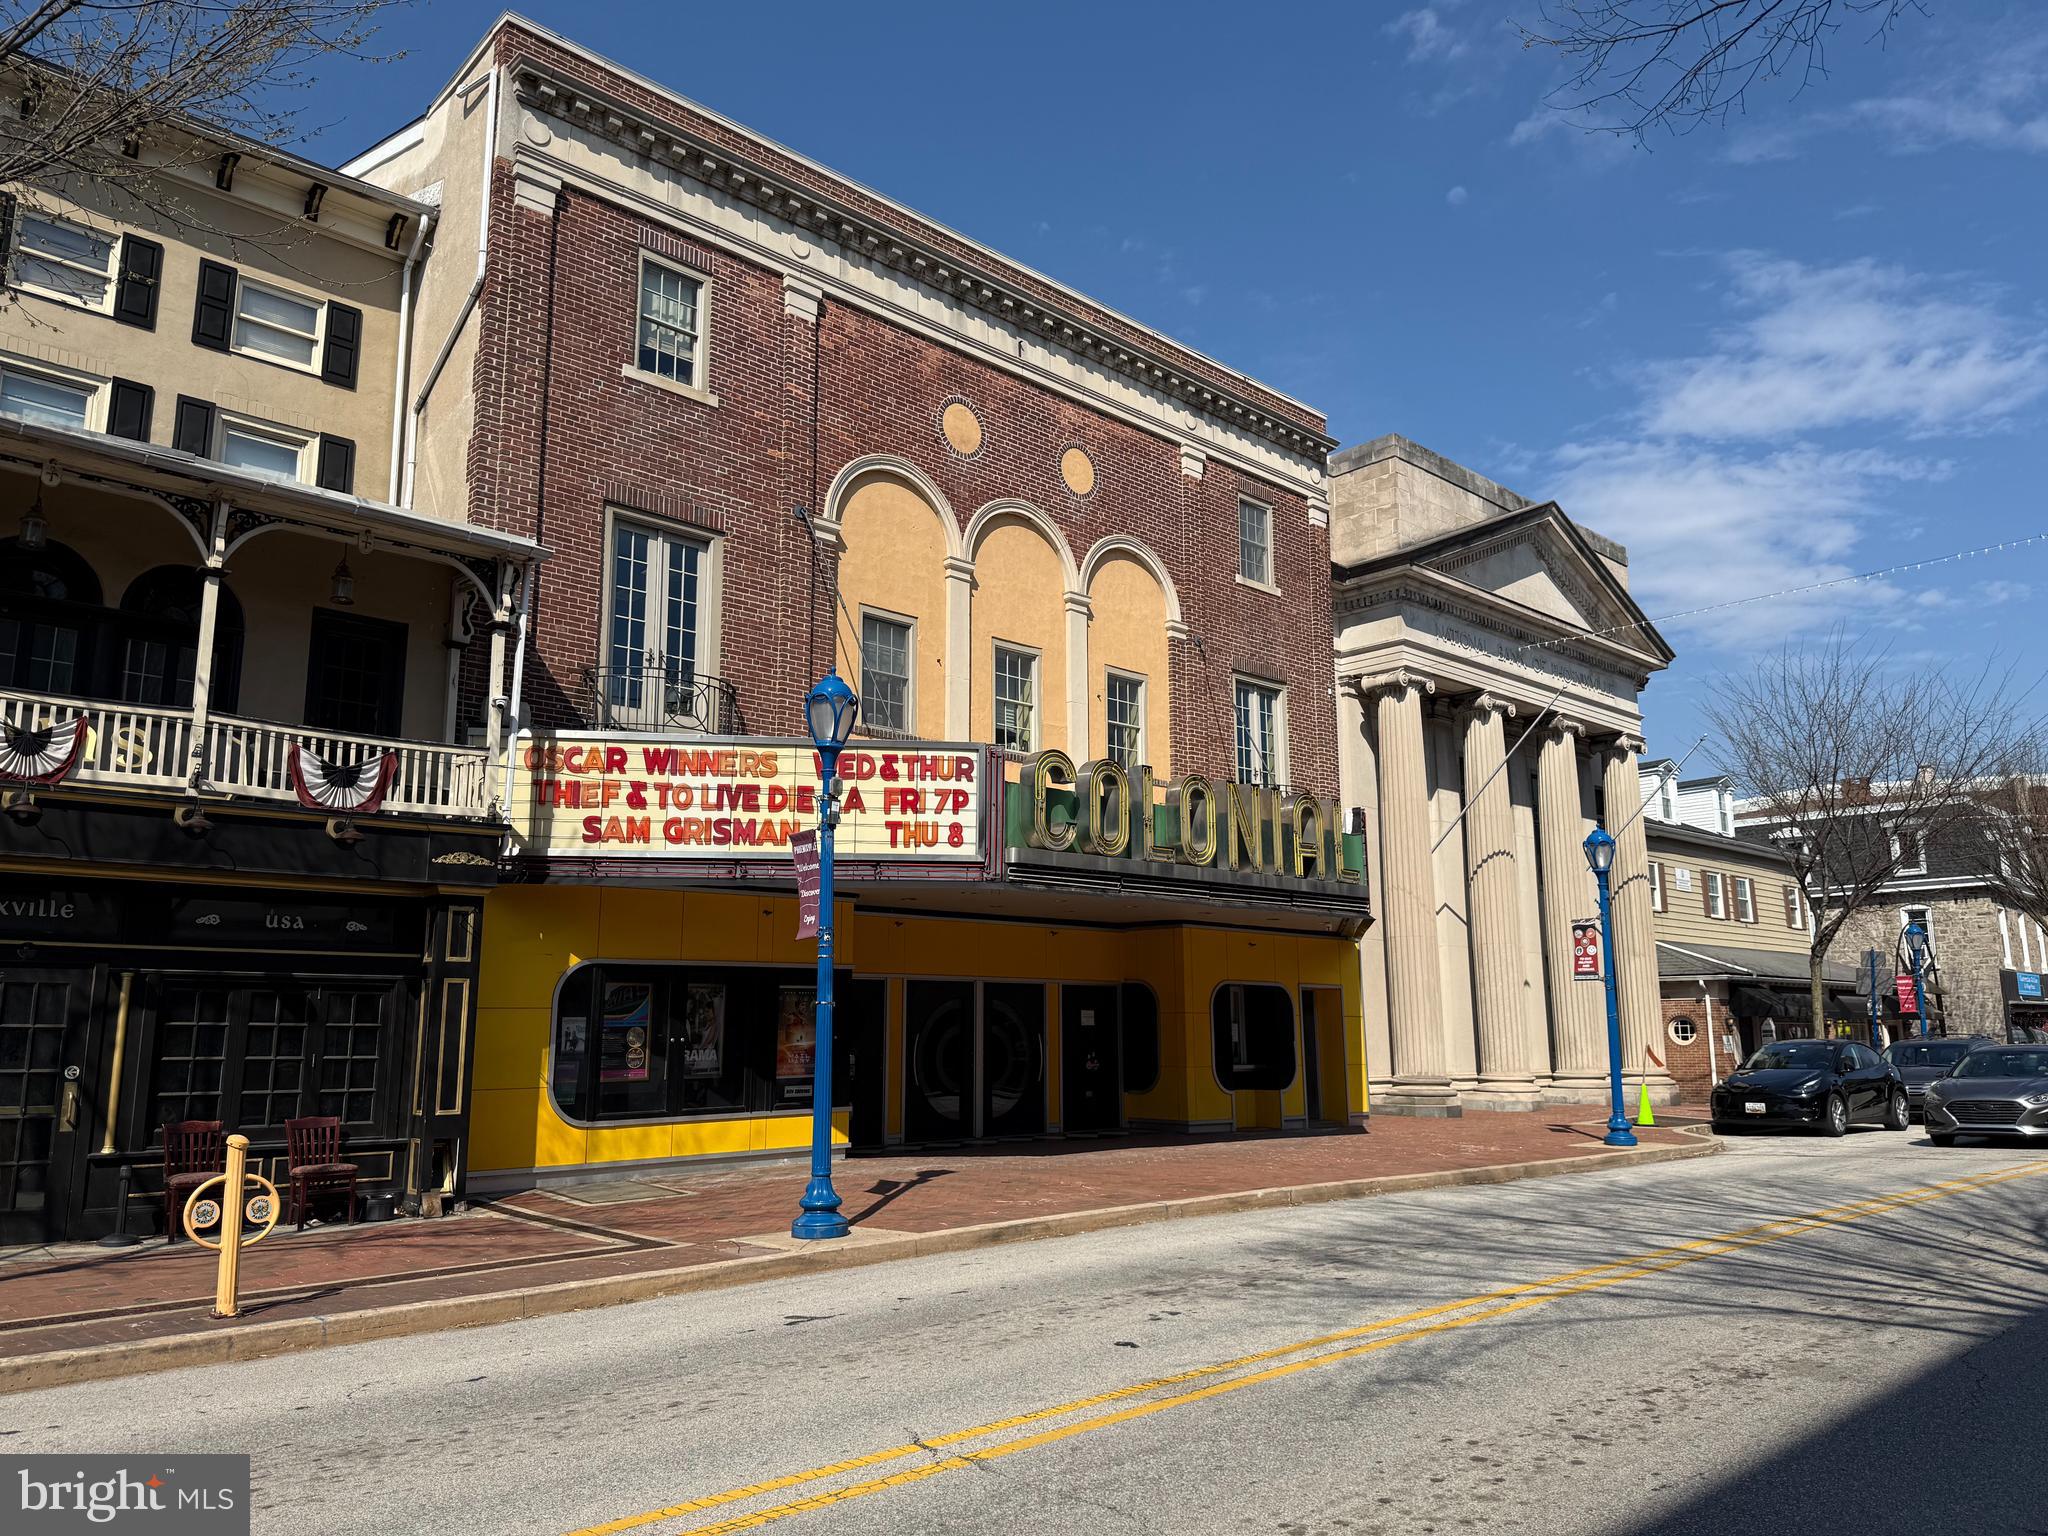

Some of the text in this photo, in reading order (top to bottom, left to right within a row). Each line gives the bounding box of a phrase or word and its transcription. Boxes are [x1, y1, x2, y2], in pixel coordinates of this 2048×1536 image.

[1435, 623, 1491, 657] NATIONAL
[1497, 643, 1527, 669] BANK
[524, 745, 628, 774] OSCAR
[642, 747, 778, 778] WINNERS
[534, 779, 622, 809] THIEF
[626, 781, 647, 810] &
[653, 783, 693, 811] TO
[701, 783, 761, 813] LIVE
[767, 784, 815, 814] DIE
[883, 787, 926, 815] FRI
[934, 788, 970, 816] 7P
[582, 815, 964, 849] SAM GRISMAN THU 8
[1021, 749, 1361, 884] COLONIAL
[797, 862, 820, 873] Welcome
